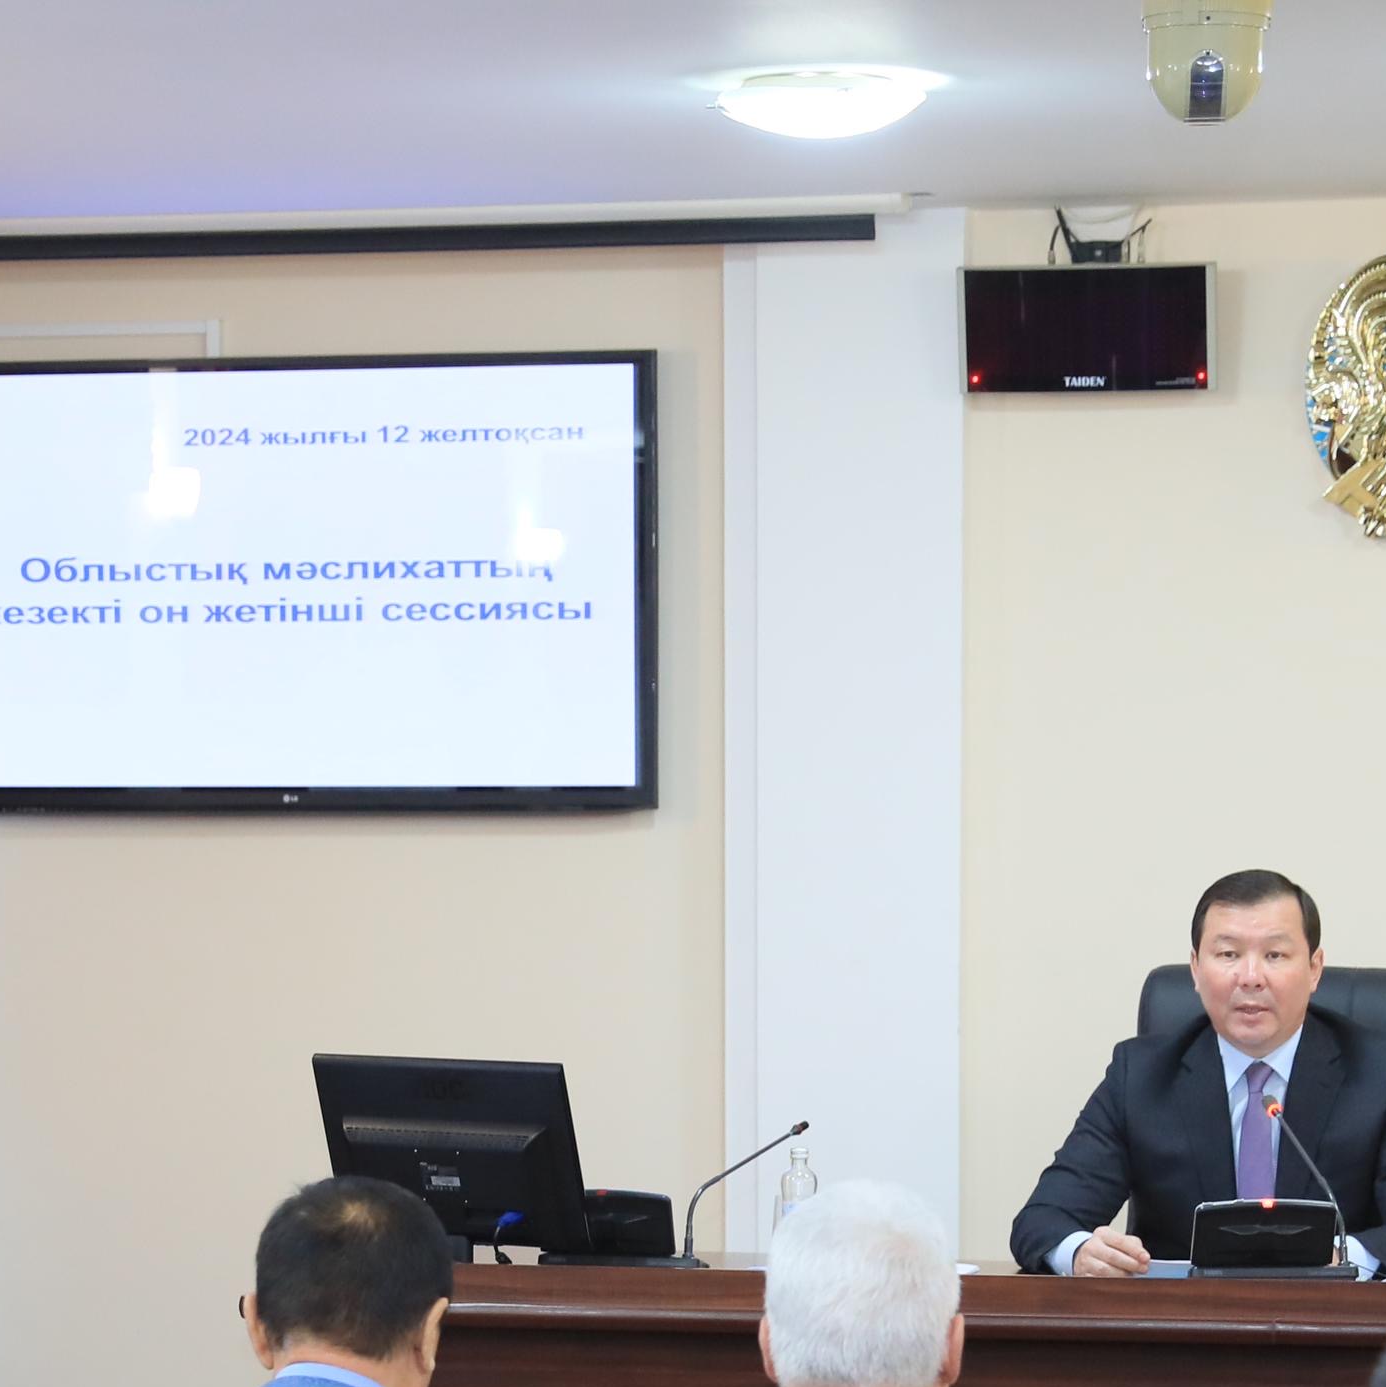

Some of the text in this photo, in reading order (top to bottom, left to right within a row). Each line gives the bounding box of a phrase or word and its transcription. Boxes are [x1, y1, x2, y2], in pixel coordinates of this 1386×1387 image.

[1063, 376, 1106, 388] TAIDEN
[183, 424, 585, 448] 2024 жылғы 12 желтоқсан
[19, 556, 554, 586] Облыстық мәслихаттың
[138, 603, 190, 625] он
[202, 596, 364, 625] жетінші
[380, 600, 593, 623] сессиясы
